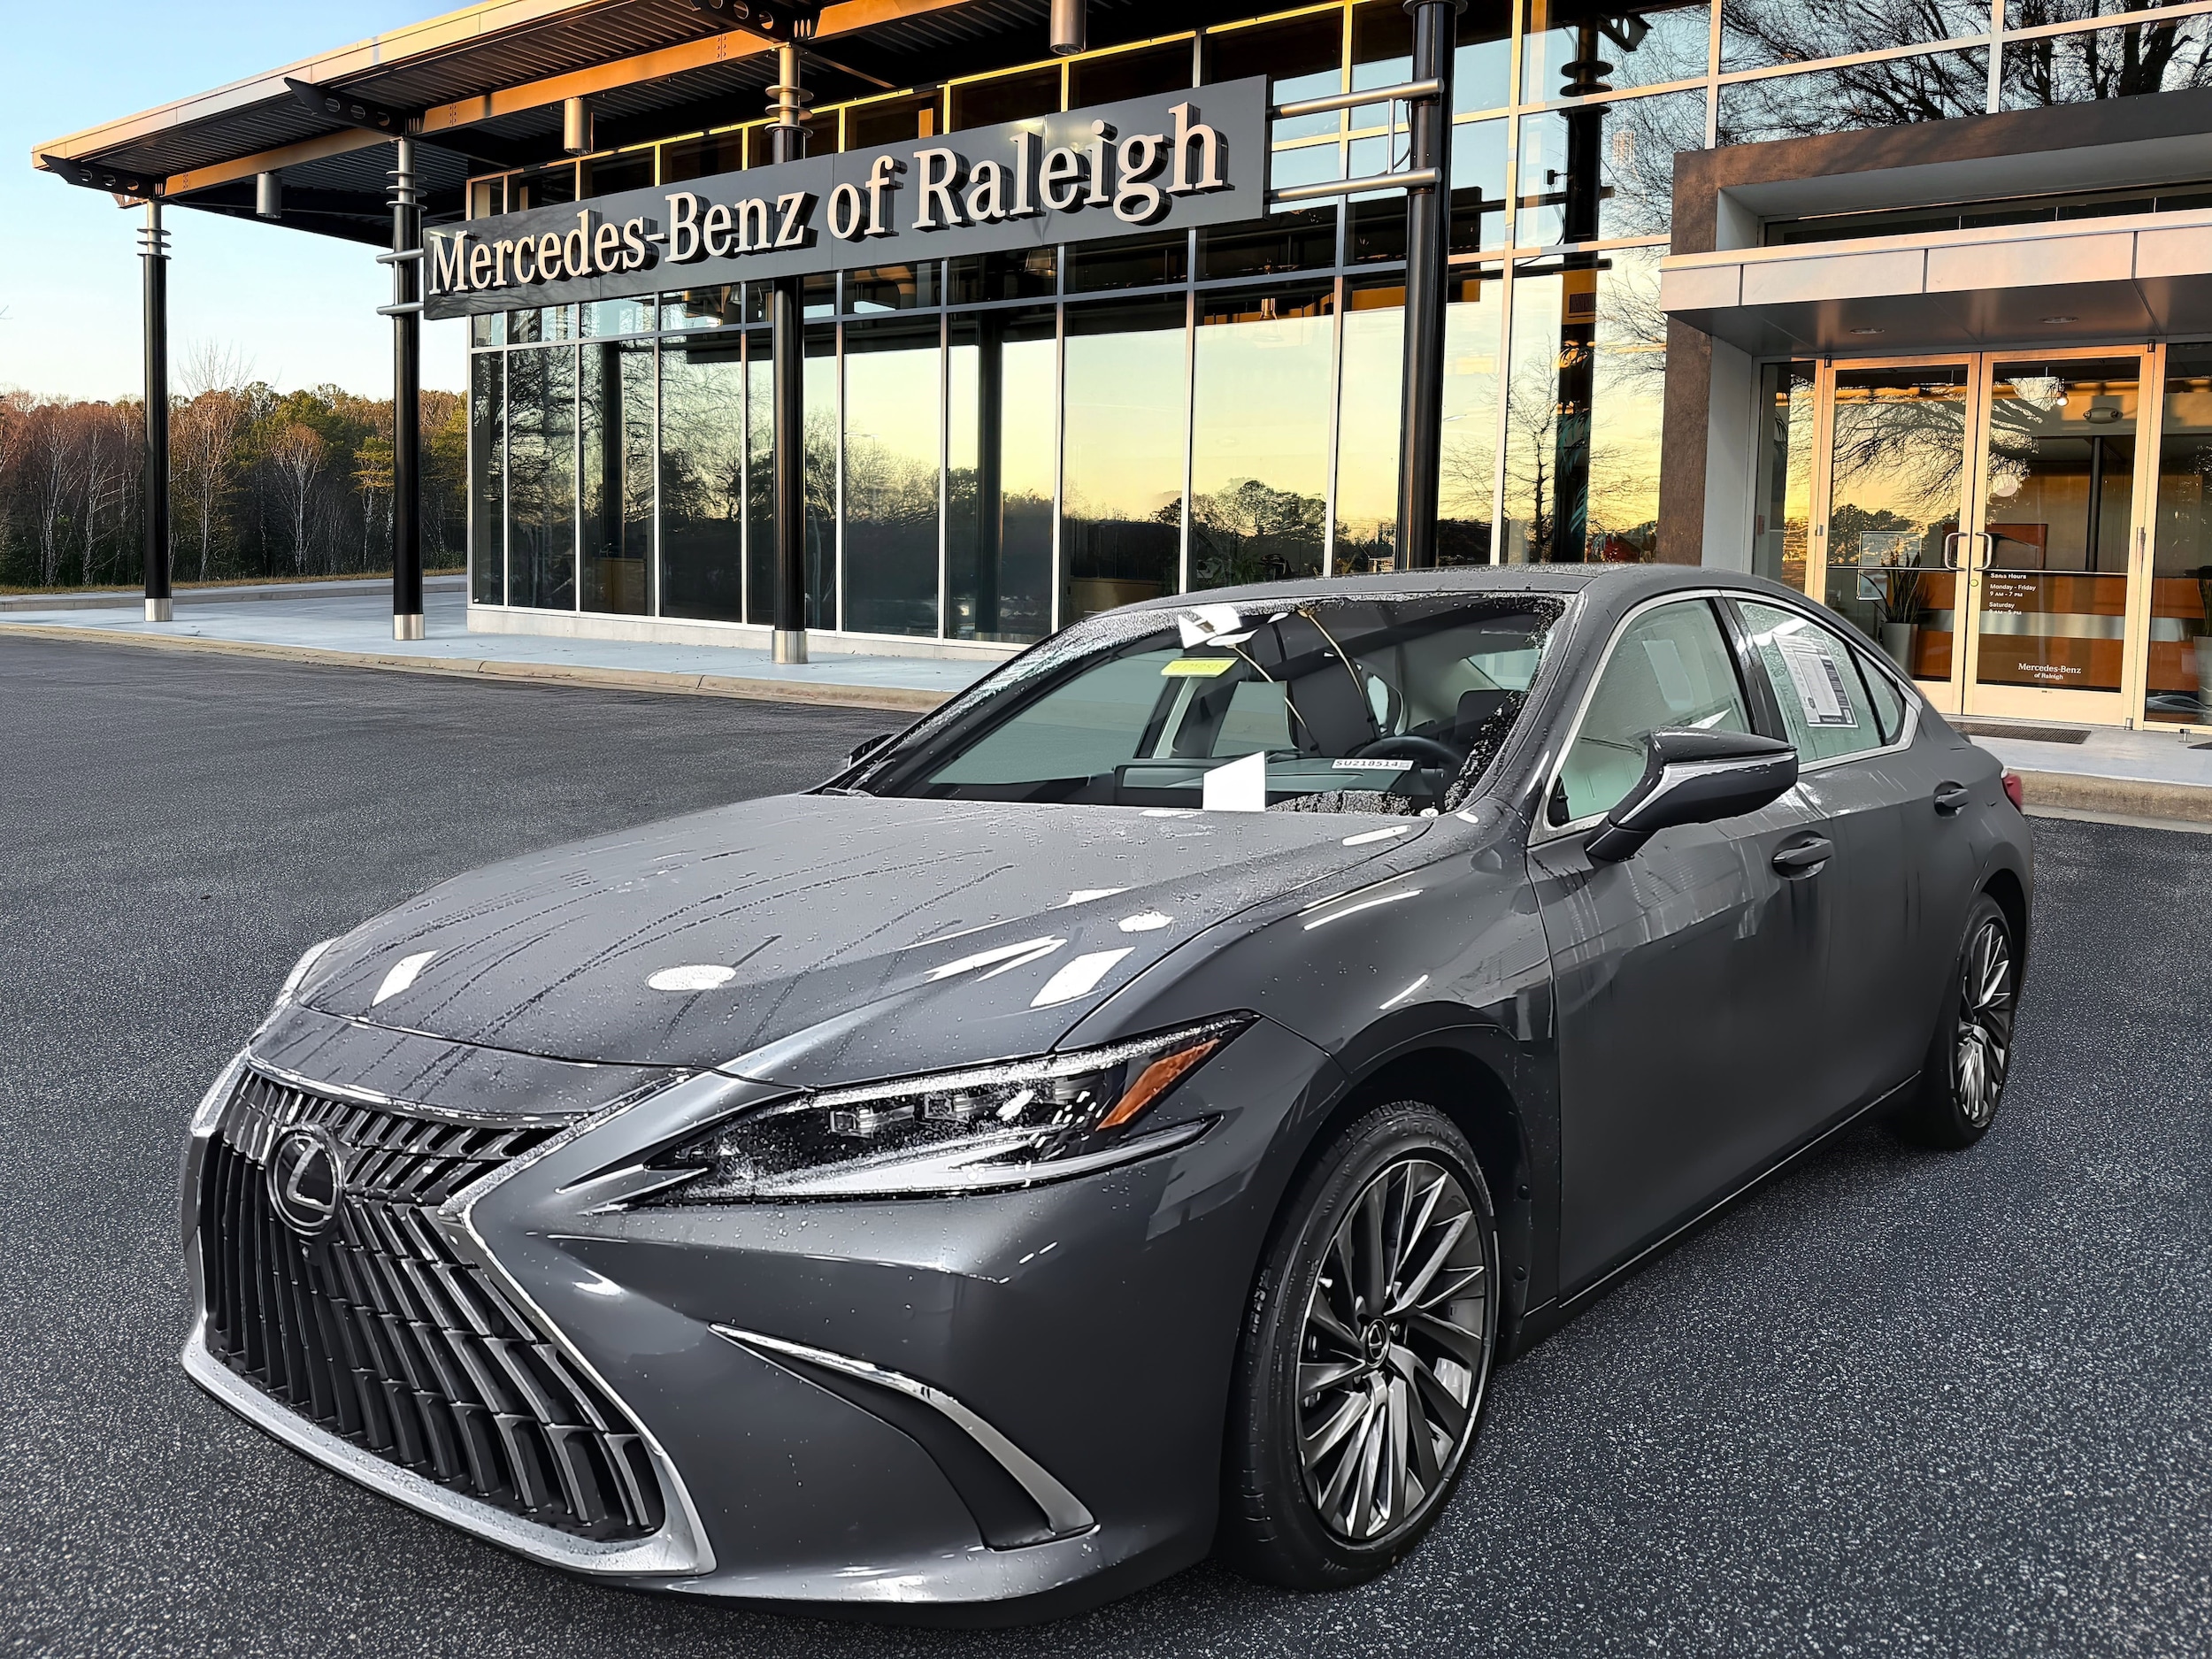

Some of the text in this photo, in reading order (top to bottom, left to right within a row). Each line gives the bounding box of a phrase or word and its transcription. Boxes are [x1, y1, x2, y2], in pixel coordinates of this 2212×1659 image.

[428, 101, 1226, 296] Mercedes-Benz of Raleigh
[2018, 663, 2081, 673] Mercedes-Benz
